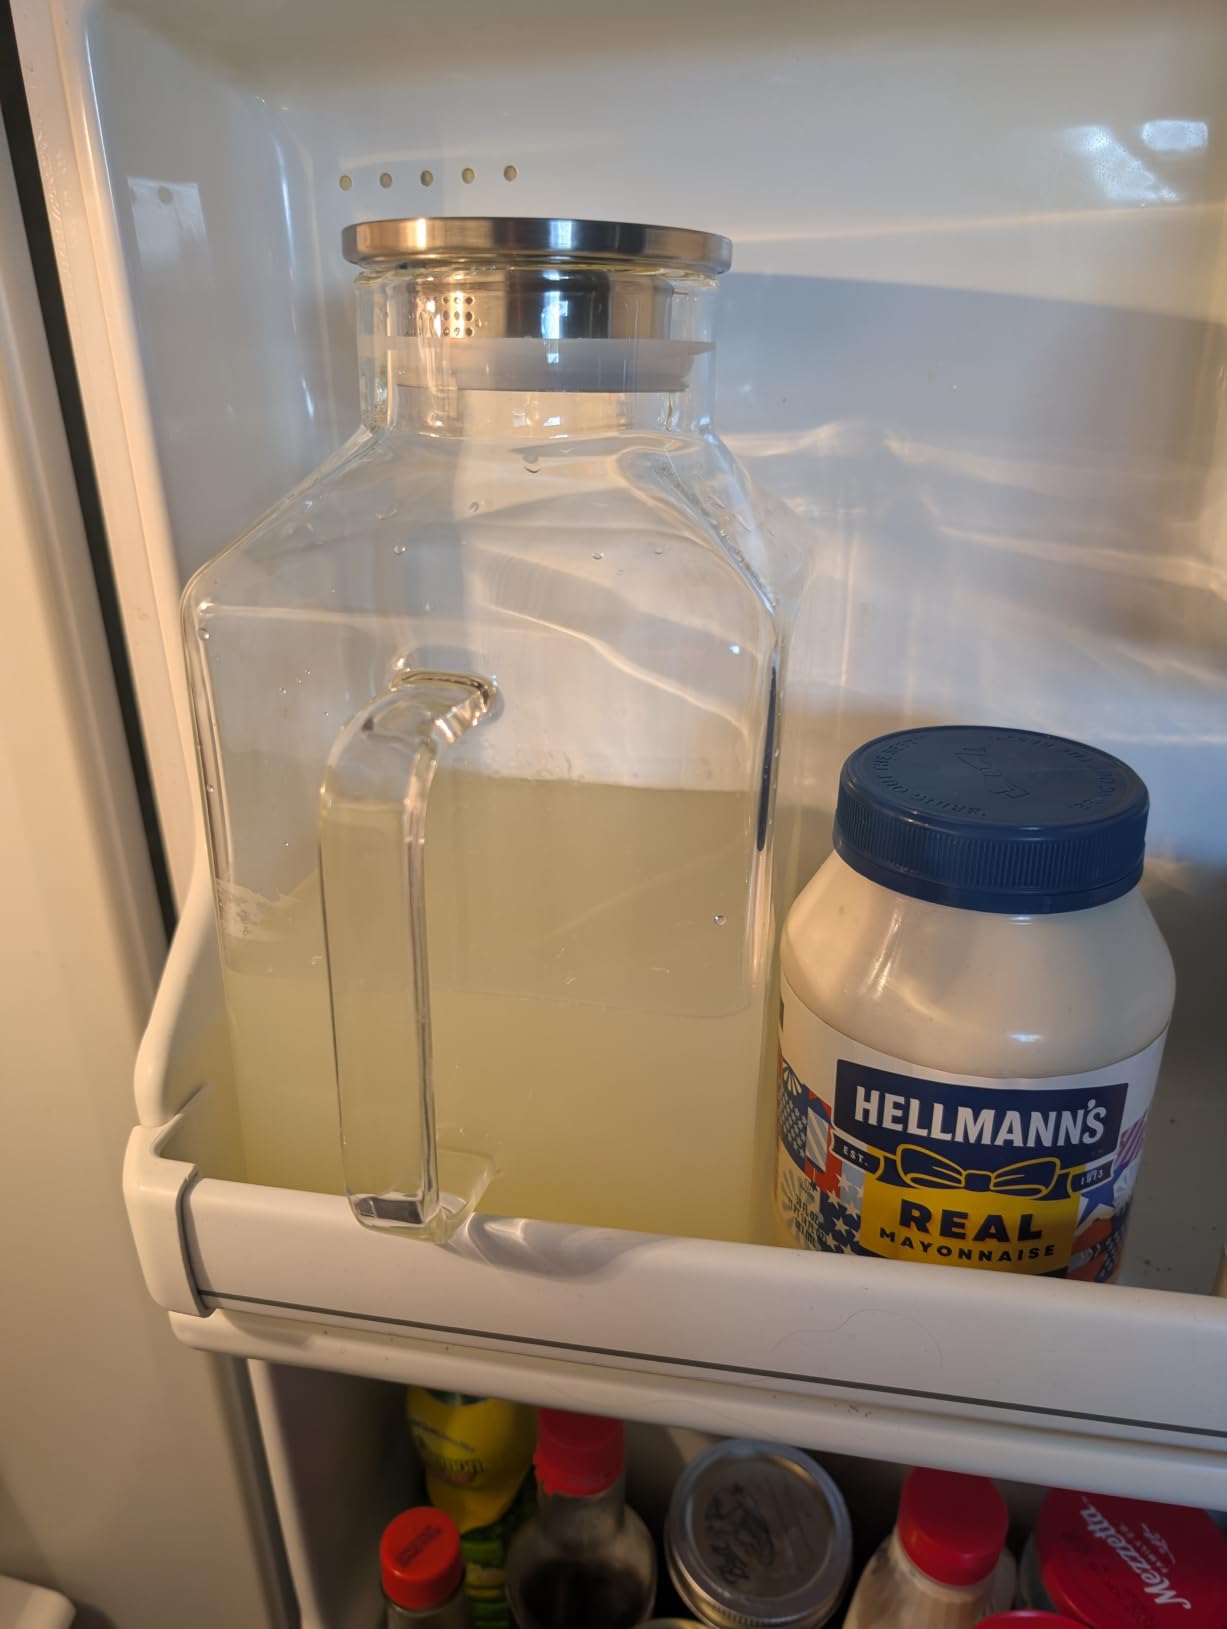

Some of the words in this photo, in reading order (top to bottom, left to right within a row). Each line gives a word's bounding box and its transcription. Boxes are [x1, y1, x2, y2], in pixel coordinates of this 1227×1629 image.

[854, 1085, 1107, 1147] HELLMANN'S
[842, 1145, 869, 1167] EST.
[898, 1198, 1043, 1243] REAL
[878, 1226, 1056, 1262] MAYONNAISE
[1079, 1496, 1192, 1610] Mezzetta
